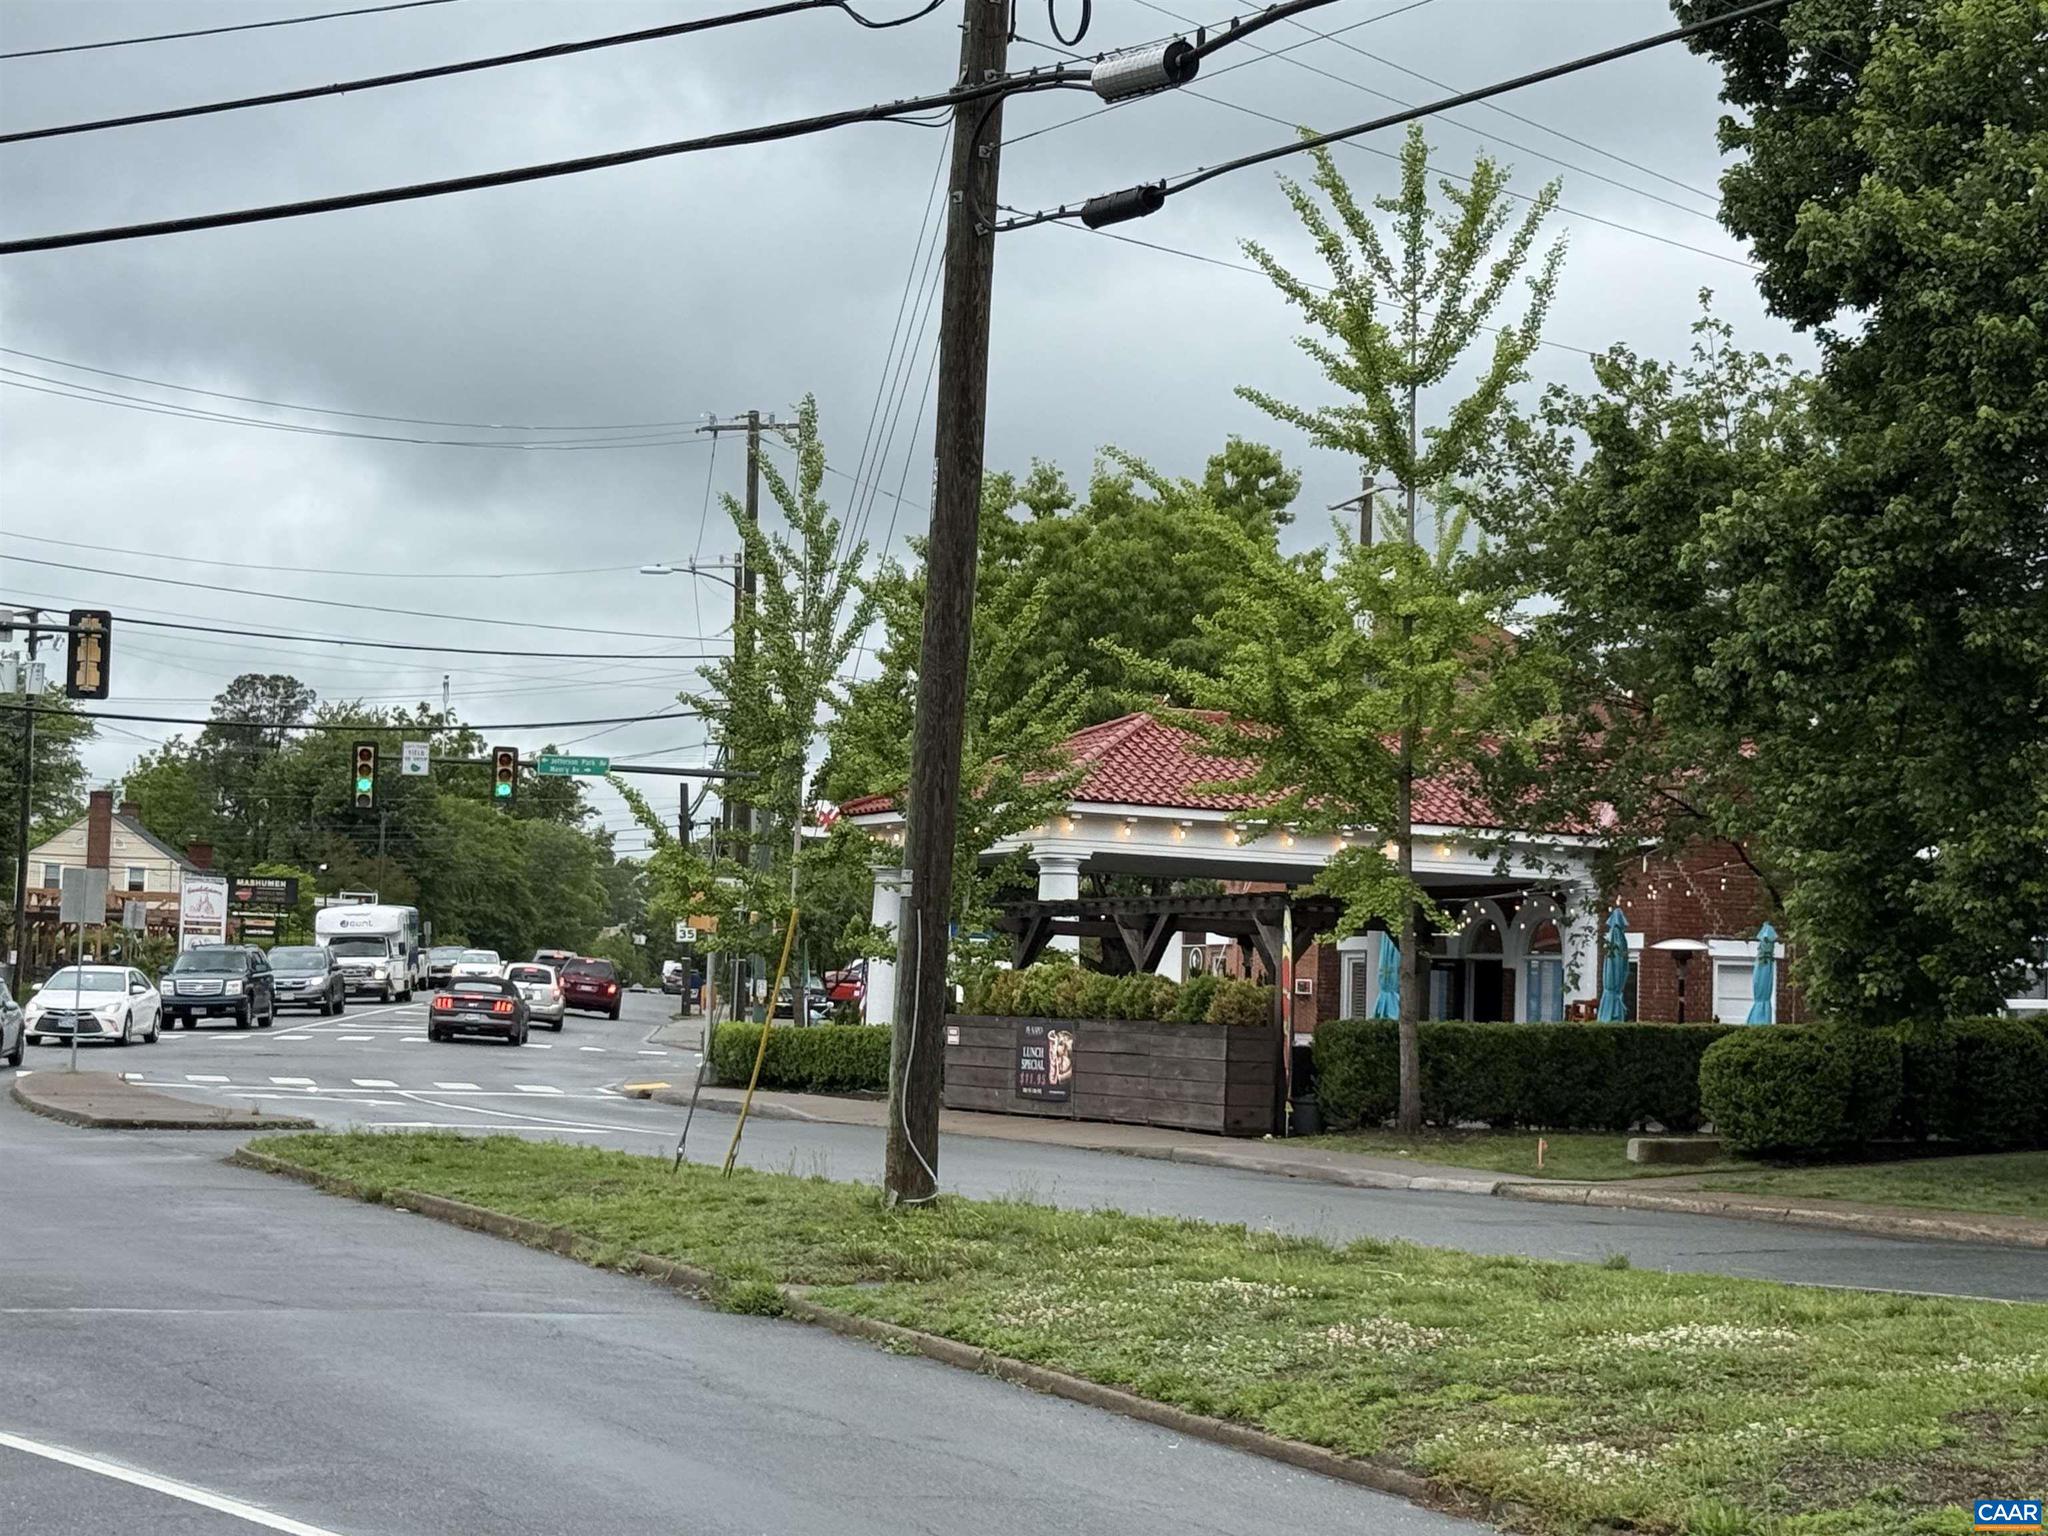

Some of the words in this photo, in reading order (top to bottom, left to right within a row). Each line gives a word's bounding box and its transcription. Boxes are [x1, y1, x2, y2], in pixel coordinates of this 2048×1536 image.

[680, 929, 695, 939] 35
[1022, 1046, 1044, 1058] LUNCH
[1021, 1058, 1045, 1070] SPECIAL
